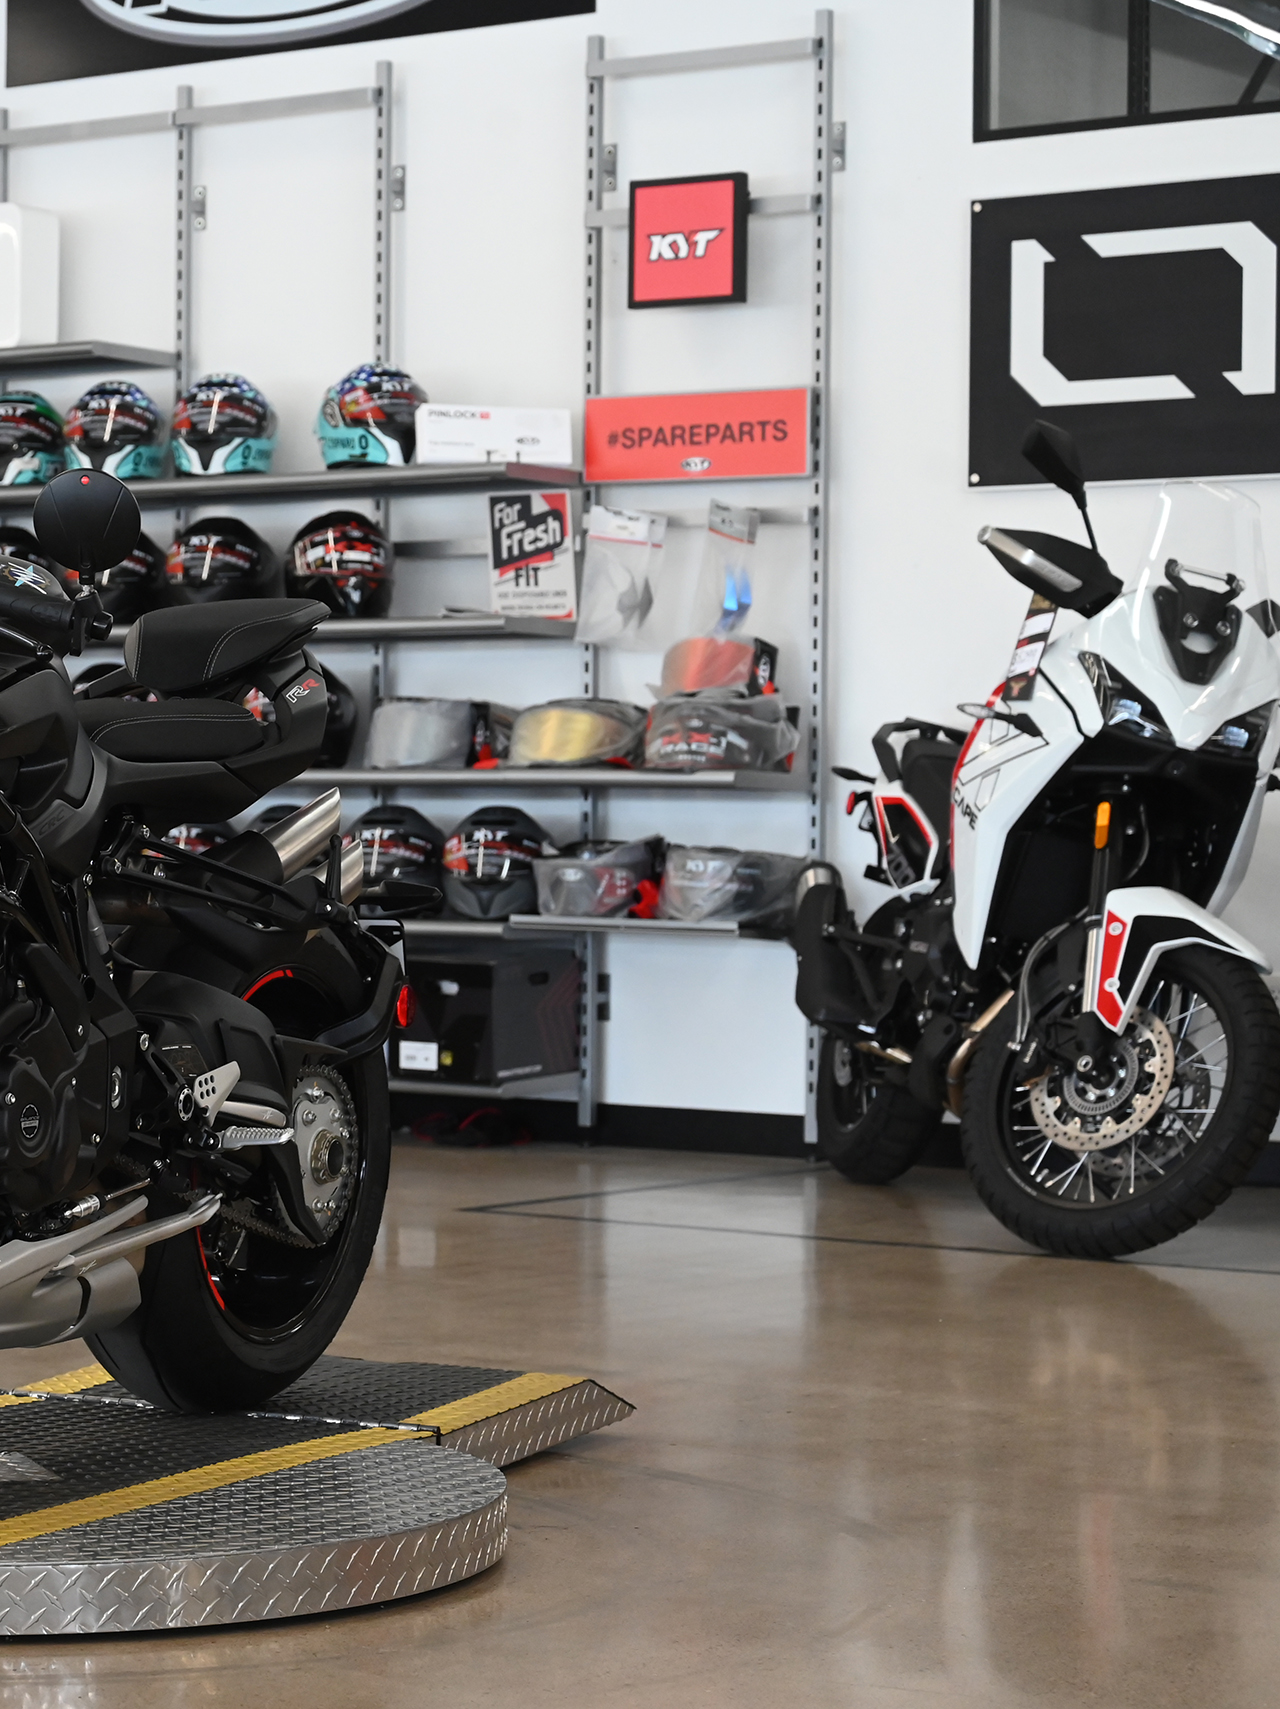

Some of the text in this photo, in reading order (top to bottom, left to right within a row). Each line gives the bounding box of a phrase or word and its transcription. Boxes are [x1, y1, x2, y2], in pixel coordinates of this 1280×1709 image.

[607, 419, 789, 449] #SPAREPARTS
[493, 502, 522, 529] For
[501, 516, 561, 560] Fresh
[285, 678, 321, 704] RR
